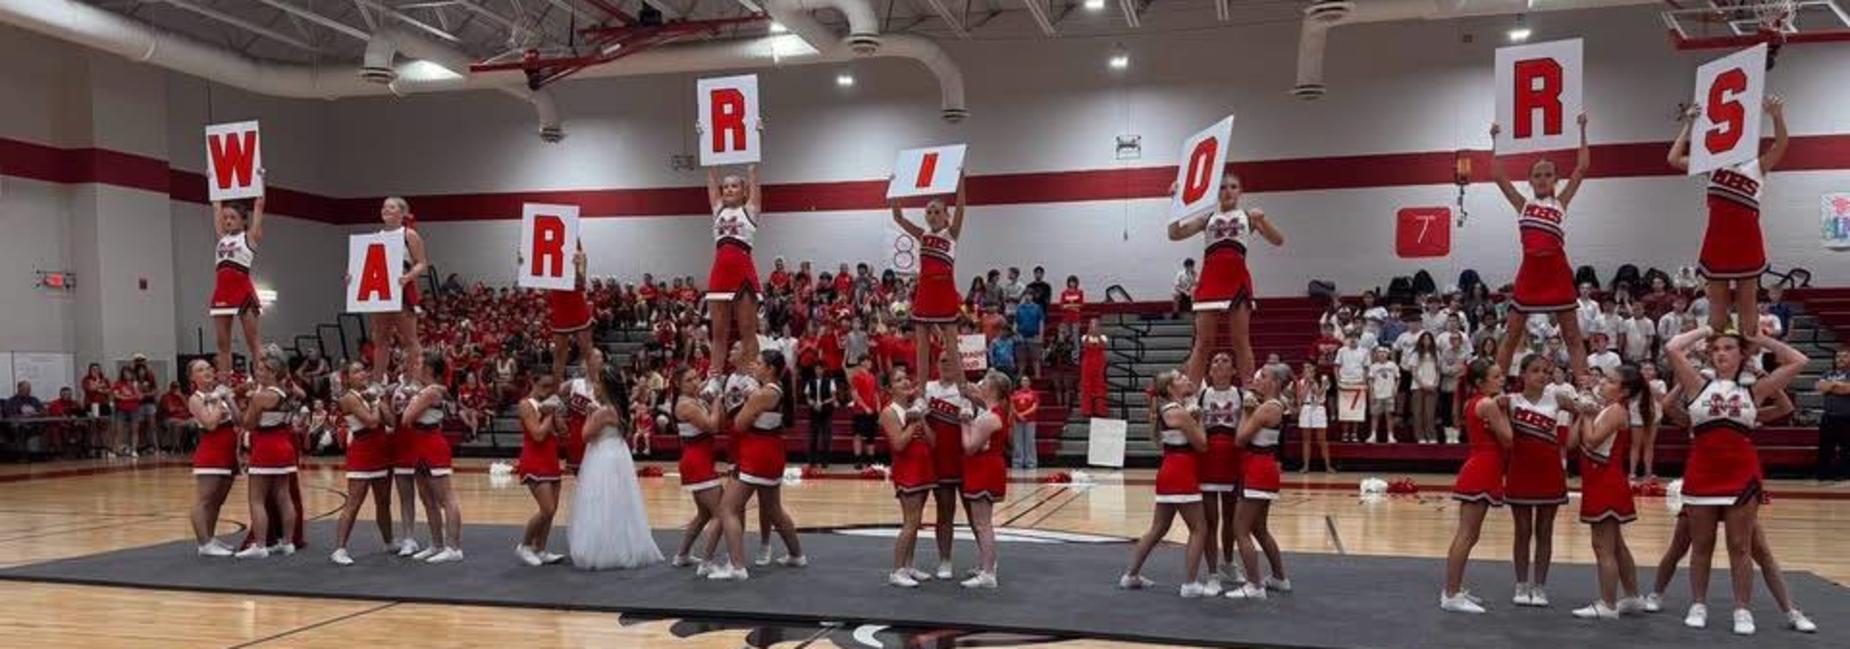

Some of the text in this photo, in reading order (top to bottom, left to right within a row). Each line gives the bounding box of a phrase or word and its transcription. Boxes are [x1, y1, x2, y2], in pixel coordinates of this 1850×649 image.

[710, 88, 747, 151] R
[1514, 57, 1561, 138] R
[1704, 68, 1746, 154] S
[208, 131, 257, 189] W
[915, 153, 937, 188] I
[1183, 136, 1219, 206] O
[532, 214, 566, 278] R
[894, 233, 914, 270] 8
[1415, 214, 1436, 244] 7
[356, 242, 392, 301] A
[1340, 386, 1366, 411] 7
